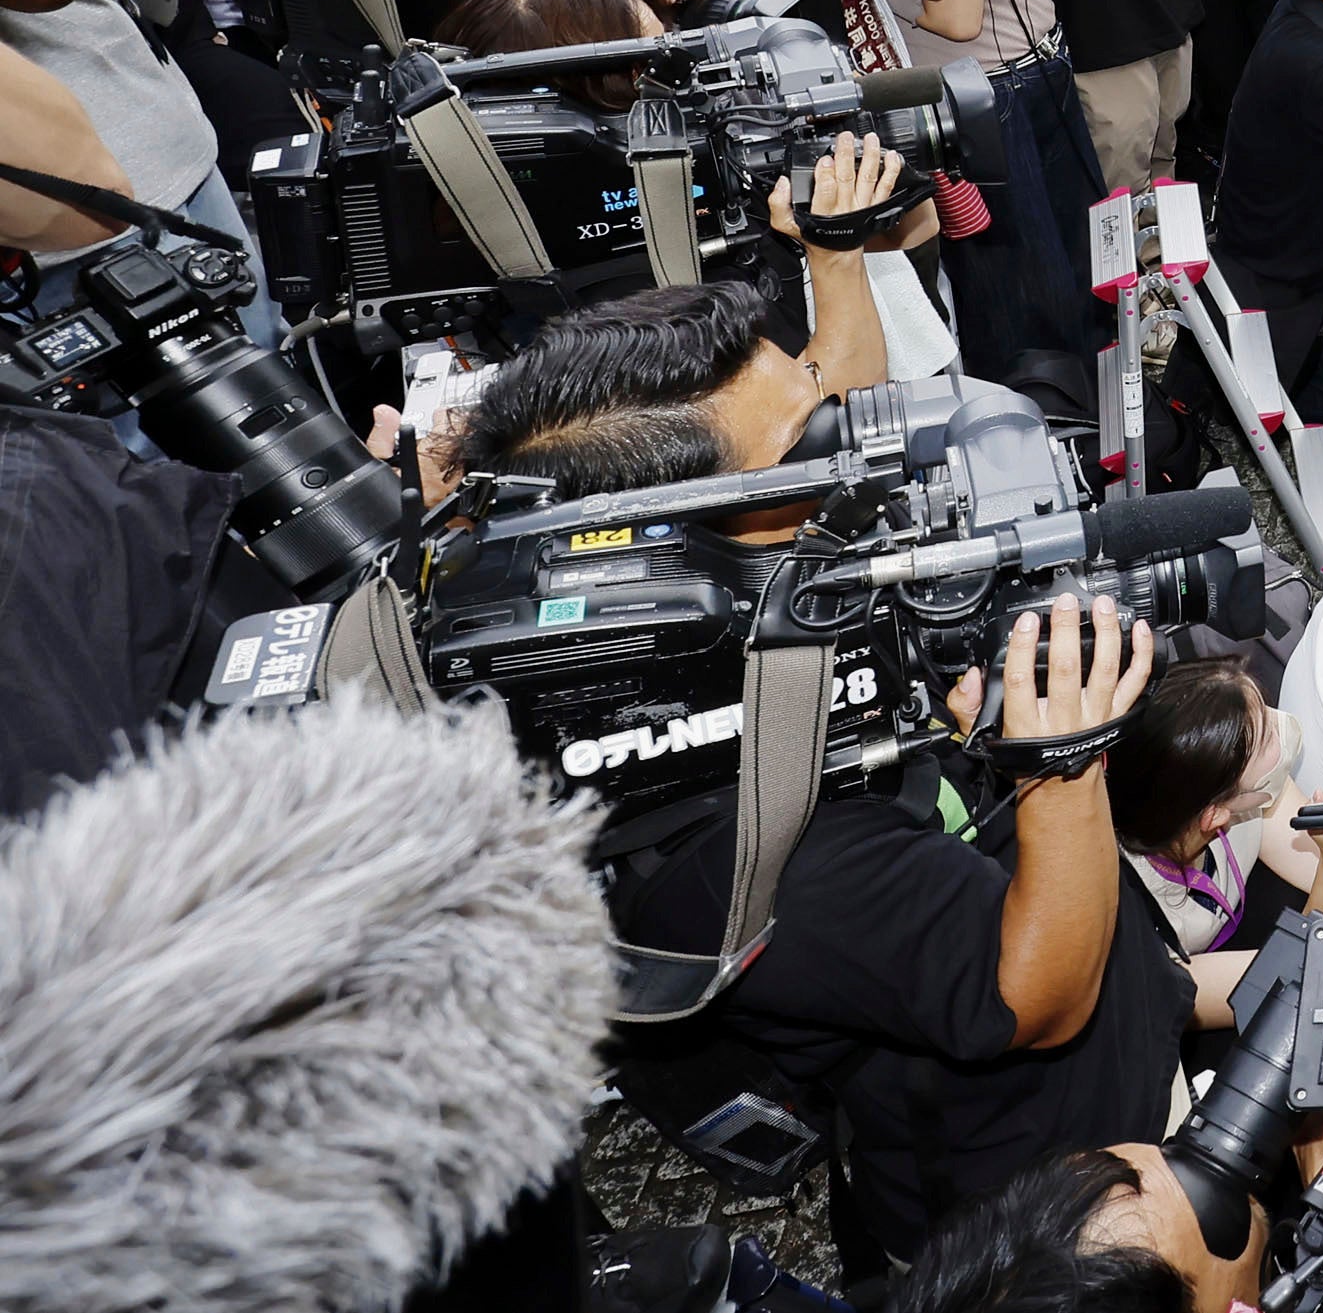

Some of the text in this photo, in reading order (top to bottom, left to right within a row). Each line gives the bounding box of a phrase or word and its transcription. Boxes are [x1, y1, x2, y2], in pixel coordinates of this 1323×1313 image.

[844, 6, 882, 71] 共同通
[876, 42, 898, 71] NEW
[602, 190, 621, 203] tv
[604, 198, 639, 212] new
[148, 308, 199, 339] Nikon
[832, 646, 871, 666] ONY
[1041, 730, 1120, 759] FUJINON
